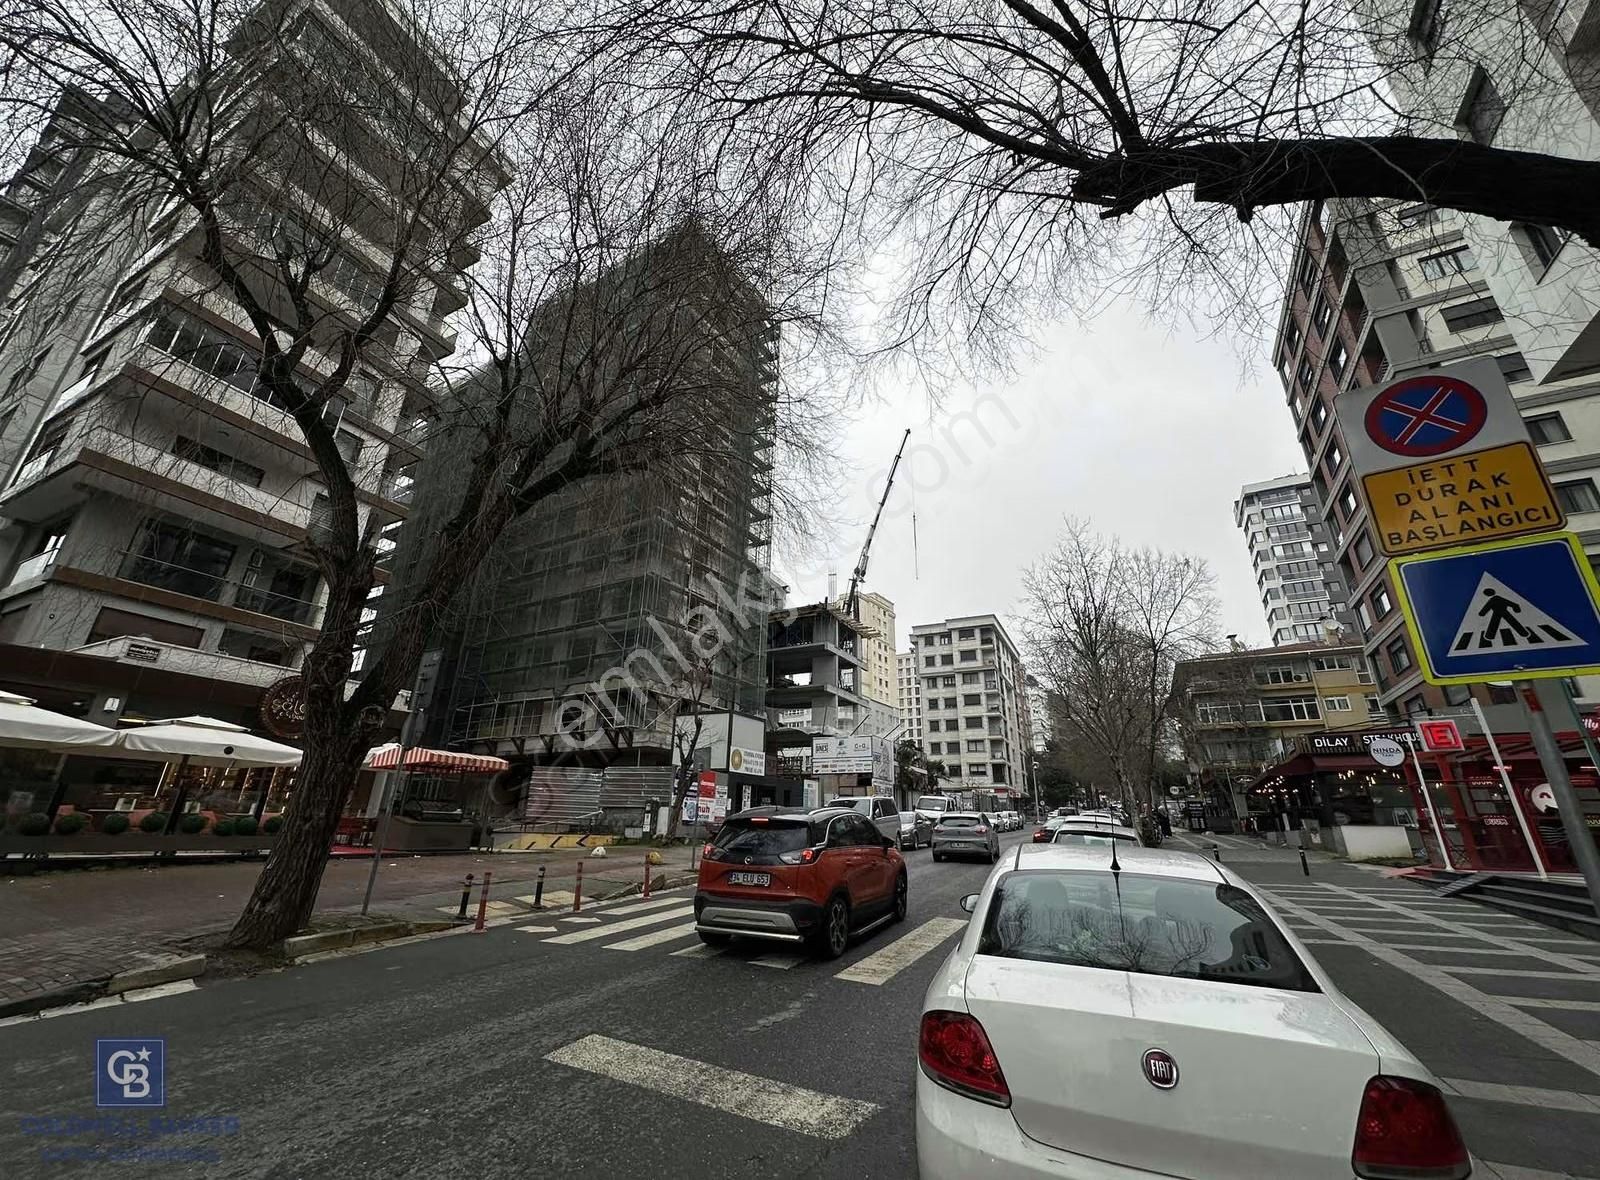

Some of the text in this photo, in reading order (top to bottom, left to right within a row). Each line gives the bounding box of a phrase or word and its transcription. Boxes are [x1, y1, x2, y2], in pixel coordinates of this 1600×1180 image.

[1408, 458, 1480, 485] İETT
[1395, 472, 1511, 507] DURAK
[1408, 492, 1515, 524] ALANI
[1387, 505, 1552, 546] BAŞLANGICI
[1314, 736, 1349, 748] DİLAY
[1150, 1059, 1171, 1079] FIAT
